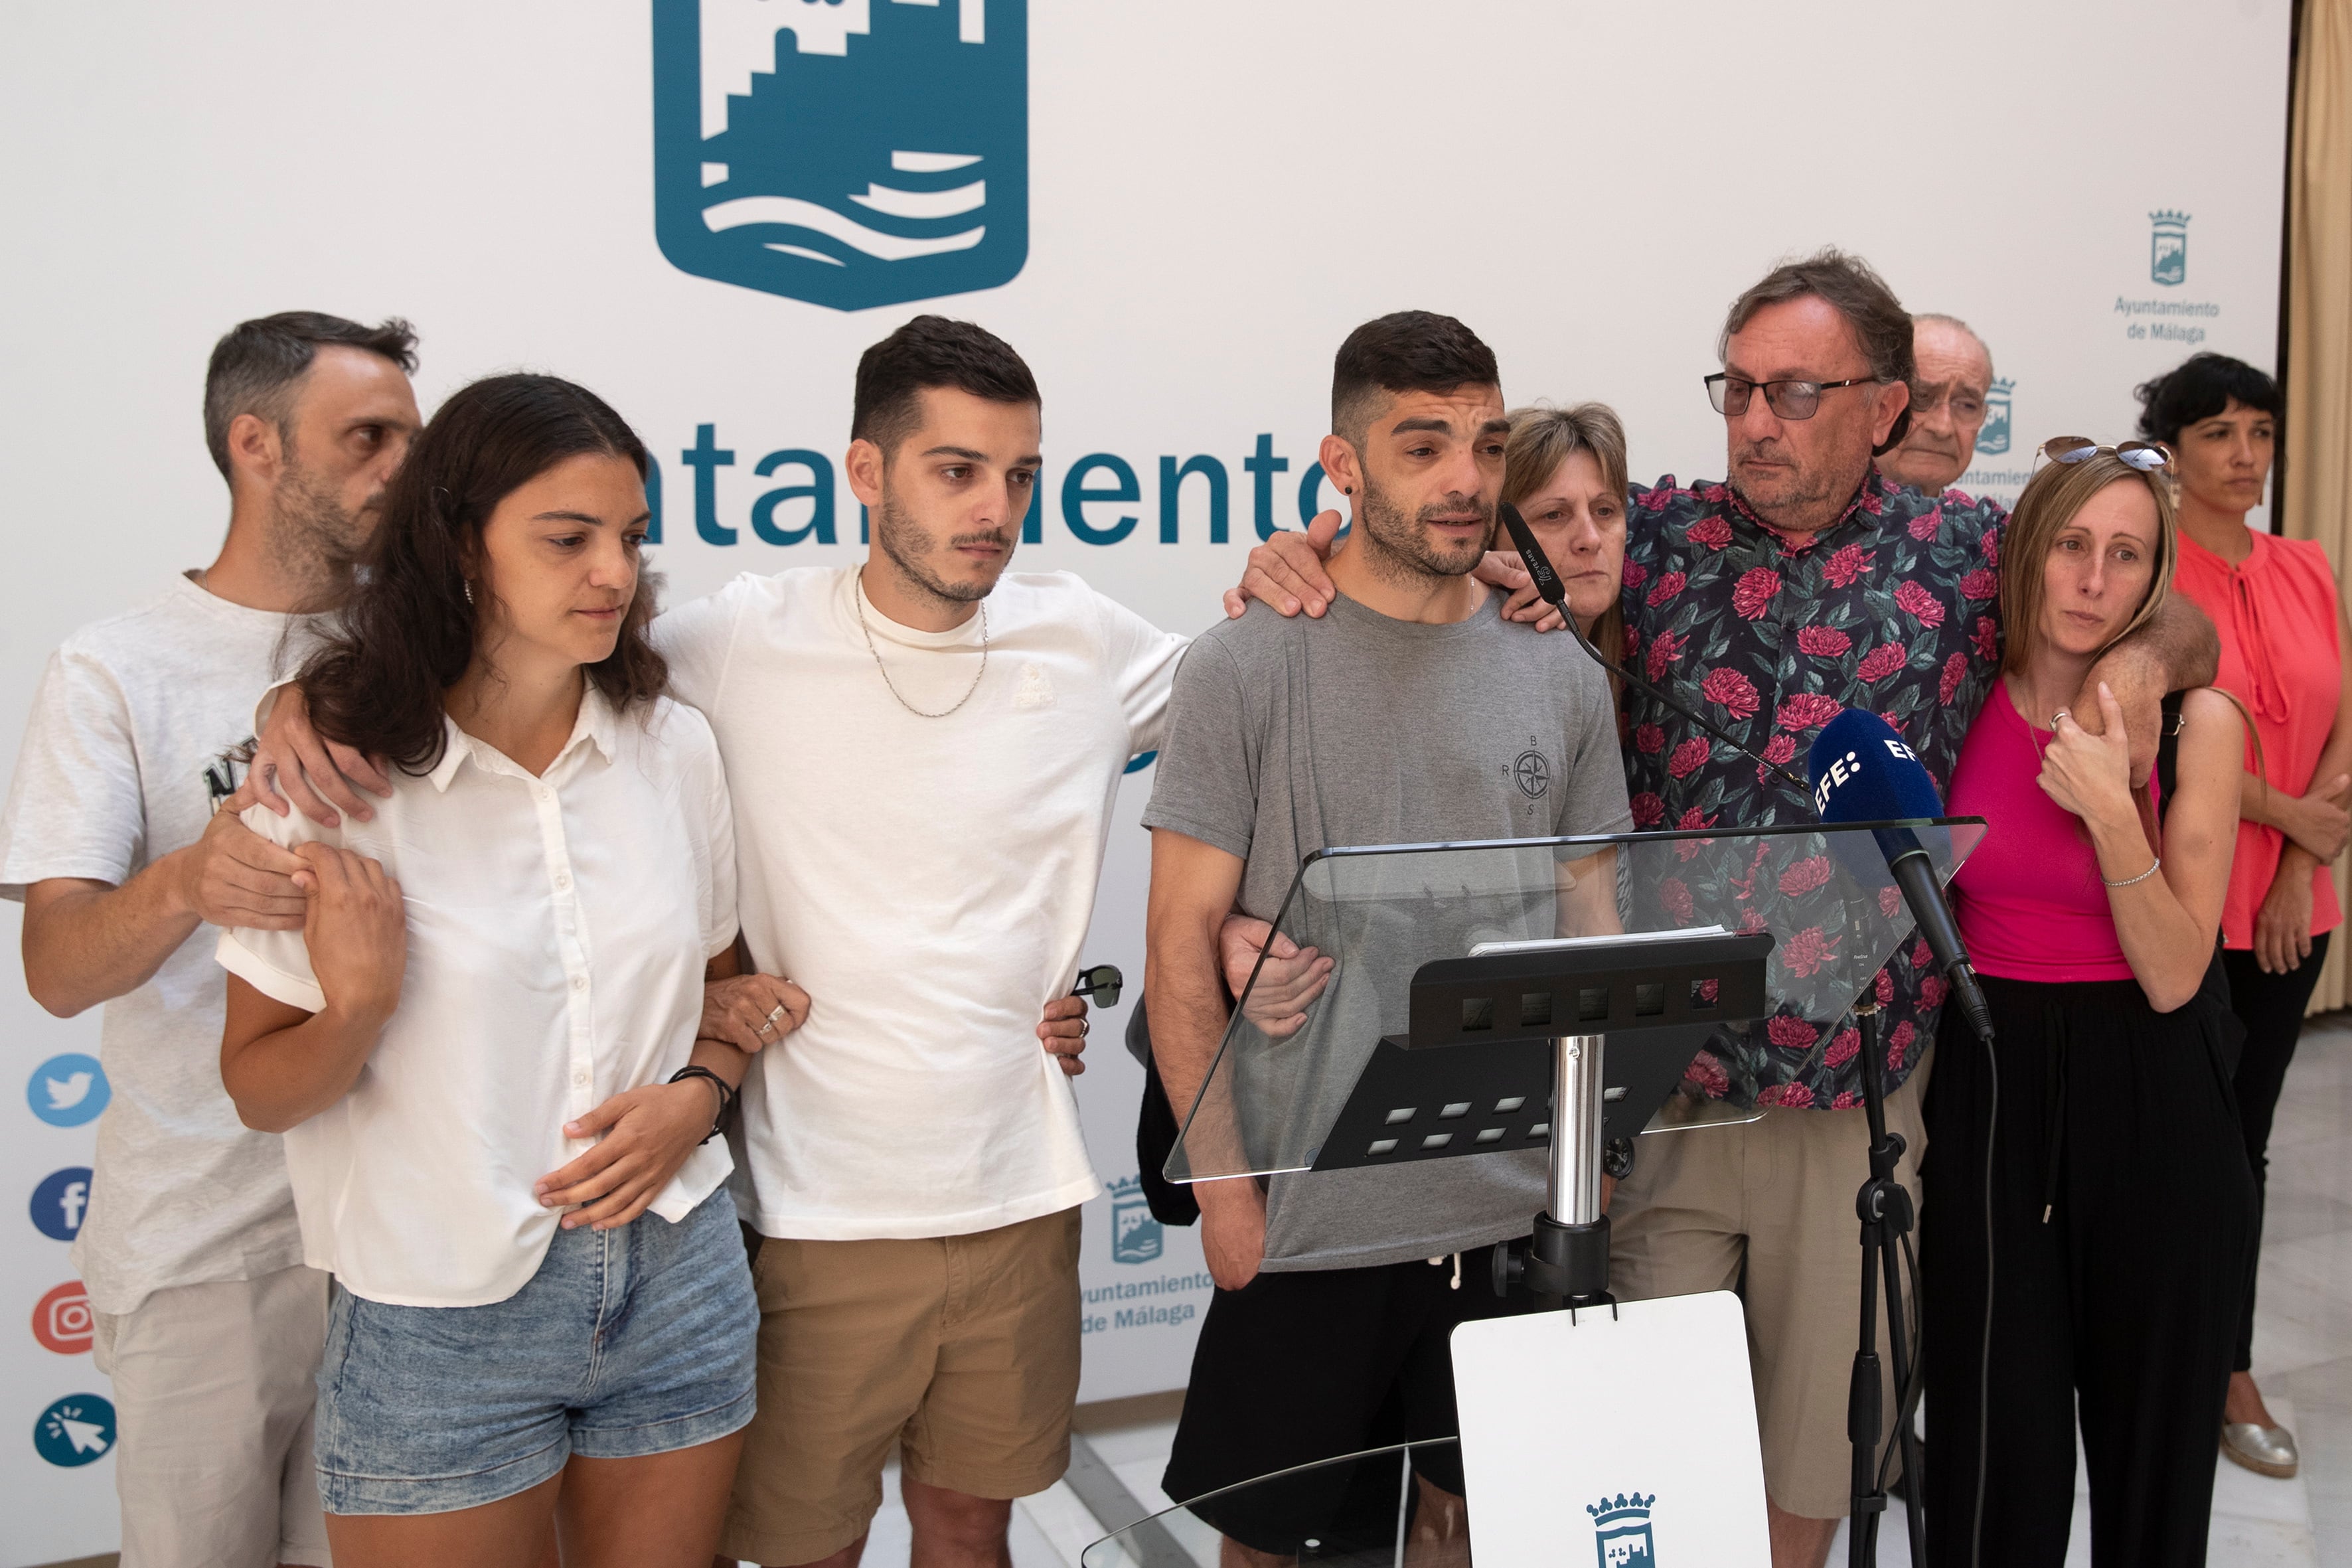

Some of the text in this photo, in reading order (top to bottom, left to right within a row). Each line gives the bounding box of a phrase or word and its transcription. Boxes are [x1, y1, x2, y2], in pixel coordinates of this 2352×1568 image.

[2114, 295, 2221, 317] Ayuntamiento
[2126, 322, 2205, 345] de Málaga
[1526, 548, 1540, 571] YEARS
[1531, 735, 1537, 746] B
[1502, 765, 1510, 776] R
[1527, 804, 1534, 815] S
[1114, 1303, 1196, 1329] Málaga
